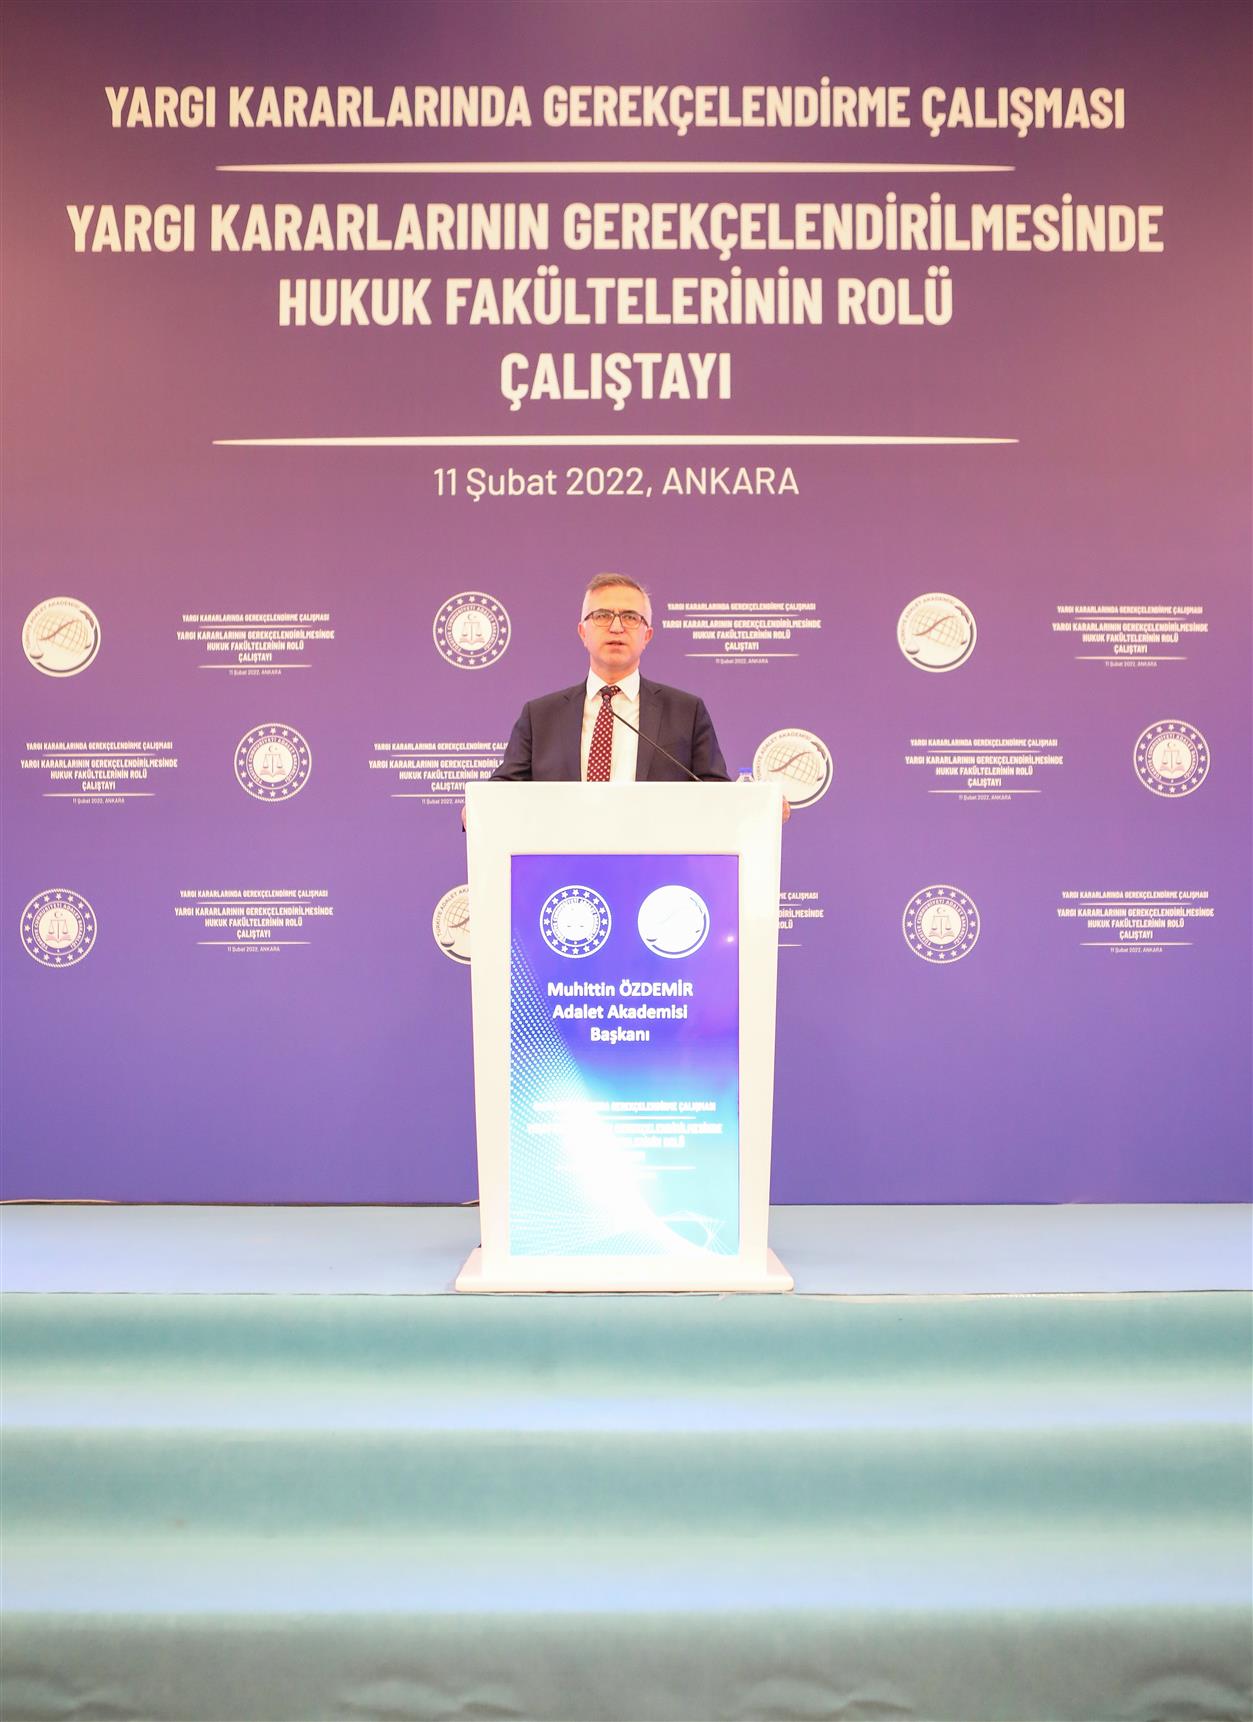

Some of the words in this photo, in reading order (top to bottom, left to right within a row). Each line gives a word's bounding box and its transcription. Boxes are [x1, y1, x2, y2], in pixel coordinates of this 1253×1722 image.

[105, 86, 215, 127] YARGI
[230, 86, 531, 127] KARARLARINDA
[544, 76, 910, 136] GEREKÇELENDİRME
[922, 86, 1127, 138] ÇALIŞMASI
[67, 204, 195, 252] YARGI
[211, 203, 548, 251] KARARLARININ
[564, 192, 1164, 259] GEREKÇELENDİRİLMESİNDE
[279, 279, 431, 326] HUKUK
[447, 266, 822, 325] FAKÜLTELERİNİN
[838, 266, 953, 325] ROLÜ
[501, 353, 731, 411] ÇALIŞTAYI
[434, 468, 456, 495] 11
[467, 468, 557, 502] Şubat
[567, 467, 652, 500] 2022,
[662, 467, 799, 495] ANKARA
[1052, 623, 1071, 631] YARGI
[1073, 623, 1121, 631] KARARLARININ
[177, 632, 196, 640] YARGI
[1083, 634, 1105, 642] HUKUK
[1106, 632, 1160, 642] FAKÜLTELERİNİN
[1162, 633, 1179, 642] ROLÜ
[231, 640, 285, 650] FAKÜLTELERİNİN
[287, 640, 304, 650] ROLÜ
[1114, 645, 1147, 654] ÇALIŞTAYI
[238, 653, 272, 662] ÇALIŞTAYI
[20, 760, 39, 768] YARGI
[41, 760, 90, 768] KARARLARININ
[389, 760, 439, 768] KARARLARININ
[926, 756, 975, 764] KARARLARININ
[50, 771, 73, 779] HUKUK
[74, 769, 129, 778] FAKÜLTELERİNİN
[130, 769, 147, 778] ROLÜ
[423, 769, 478, 779] FAKÜLTELERİNİN
[960, 766, 1014, 775] FAKÜLTELERİNİN
[1016, 766, 1033, 775] ROLÜ
[82, 782, 115, 791] ÇALIŞTAYI
[968, 778, 1001, 787] ÇALIŞTAYI
[174, 908, 193, 916] YARGI
[195, 908, 244, 916] KARARLARININ
[1057, 909, 1076, 917] YARGI
[1078, 909, 1126, 917] KARARLARININ
[205, 919, 227, 927] HUKUK
[229, 917, 284, 926] FAKÜLTELERİNİN
[285, 917, 303, 926] ROLÜ
[780, 919, 794, 929] OLÜ
[1088, 920, 1110, 928] HUKUK
[1112, 918, 1166, 927] FAKÜLTELERİNİN
[1167, 918, 1184, 927] ROLÜ
[237, 930, 271, 939] ÇALIŞTAYI
[1119, 931, 1153, 940] ÇALIŞTAYI
[547, 981, 615, 997] Muhittin
[619, 979, 694, 997] ÖZDEMİR
[552, 1004, 604, 1019] Adalet
[607, 1004, 688, 1019] Akademisi
[590, 1026, 650, 1044] Başkanı
